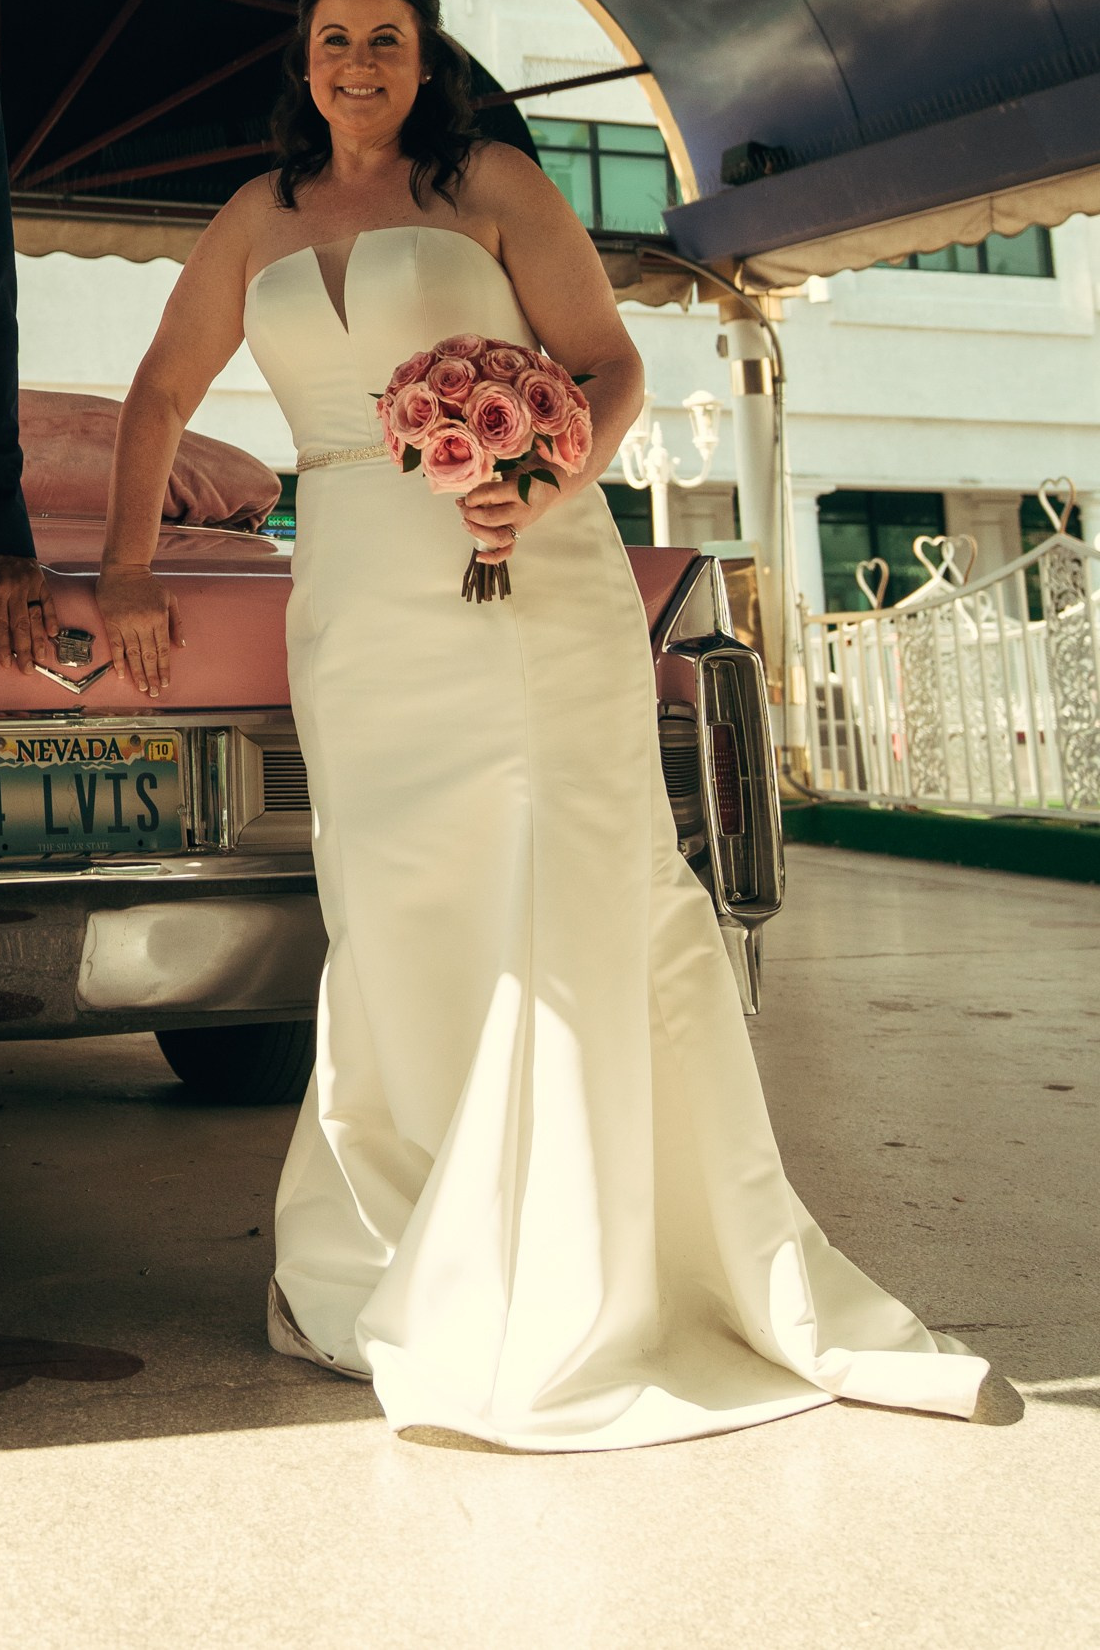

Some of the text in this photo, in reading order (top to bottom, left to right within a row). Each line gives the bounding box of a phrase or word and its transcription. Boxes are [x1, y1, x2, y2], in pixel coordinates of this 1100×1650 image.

[15, 738, 124, 762] NEVADA
[42, 772, 160, 836] LVIS
[38, 843, 54, 851] THE
